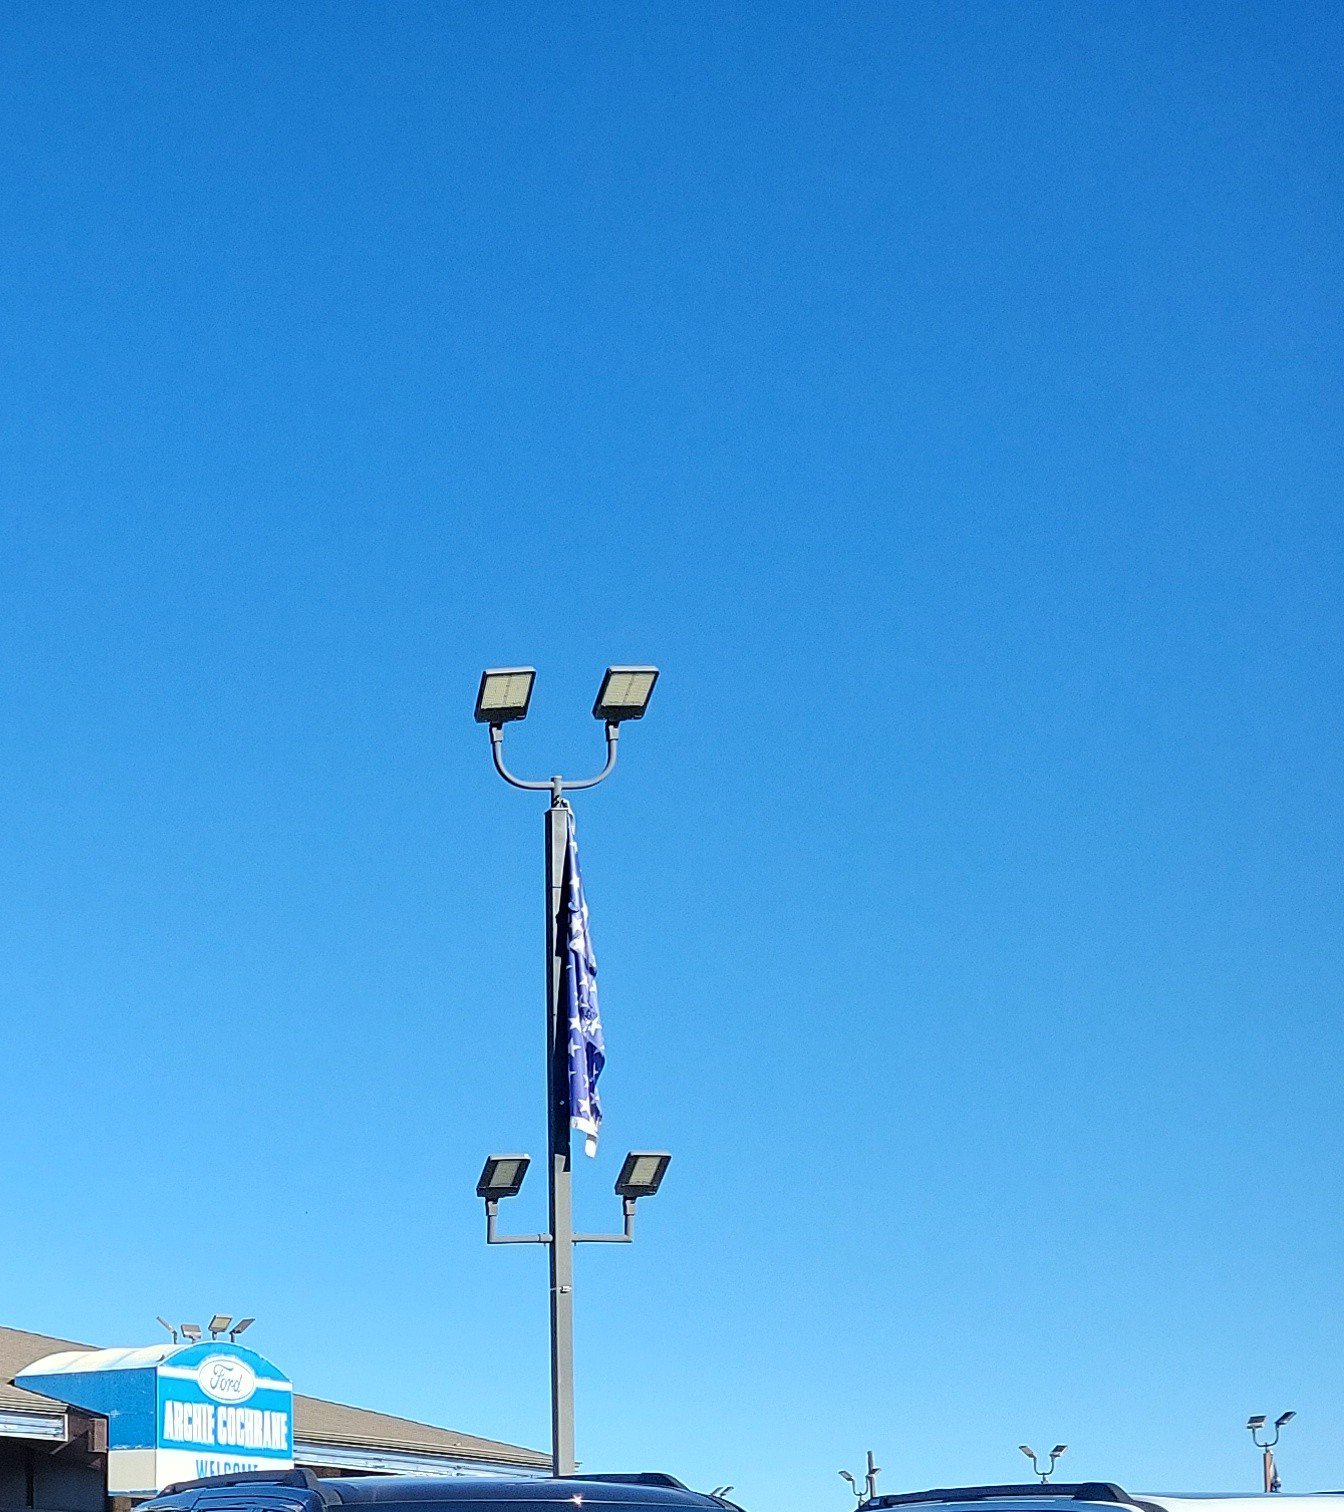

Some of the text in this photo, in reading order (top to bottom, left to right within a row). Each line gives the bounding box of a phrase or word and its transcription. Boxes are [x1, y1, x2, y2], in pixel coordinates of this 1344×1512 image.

[210, 1363, 242, 1393] Ford
[163, 1399, 288, 1450] ARCHIE COCHRANE
